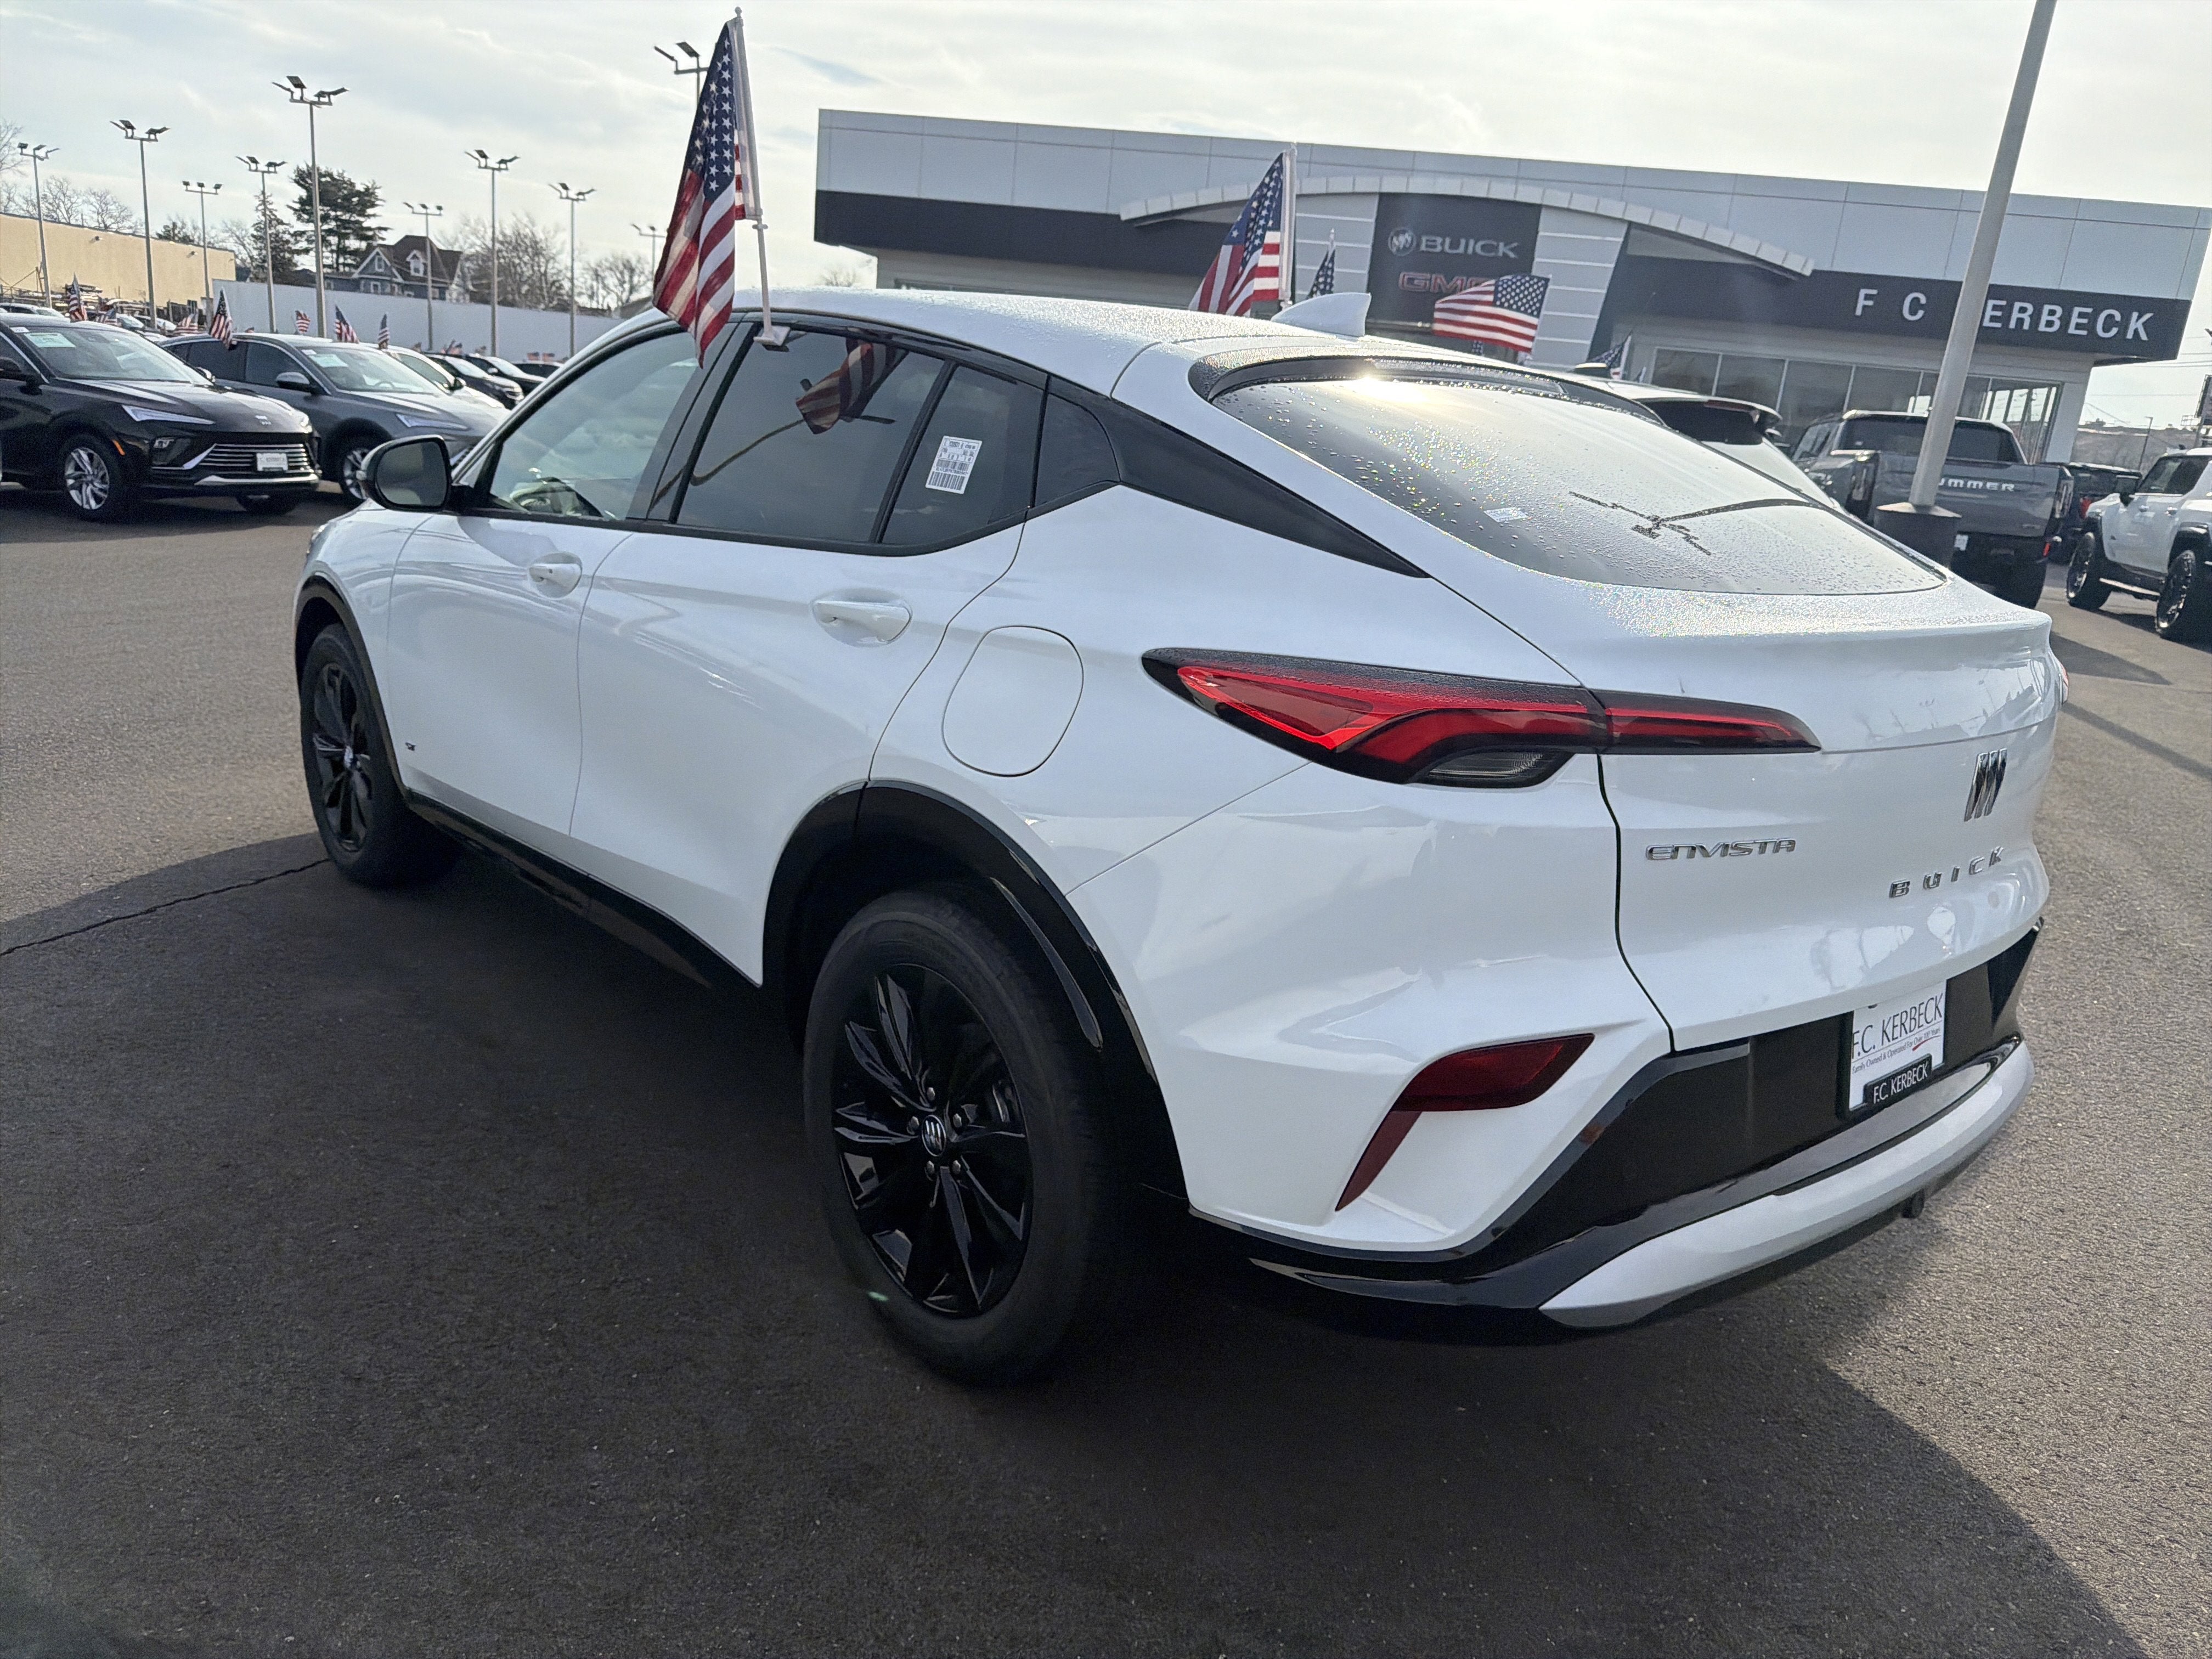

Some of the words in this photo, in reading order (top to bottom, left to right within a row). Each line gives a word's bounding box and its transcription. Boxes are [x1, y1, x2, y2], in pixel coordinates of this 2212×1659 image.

[1419, 235, 1518, 258] BUICK
[1854, 289, 1878, 316] F
[1902, 292, 1927, 321] C
[1982, 300, 2154, 341] ERBECK
[1645, 838, 1796, 861] ENVISTA
[1889, 845, 2005, 899] BUICK
[1851, 1024, 1876, 1059] F.C.
[1881, 992, 1943, 1046] KERBECK
[1891, 1061, 1928, 1096] KERBECK
